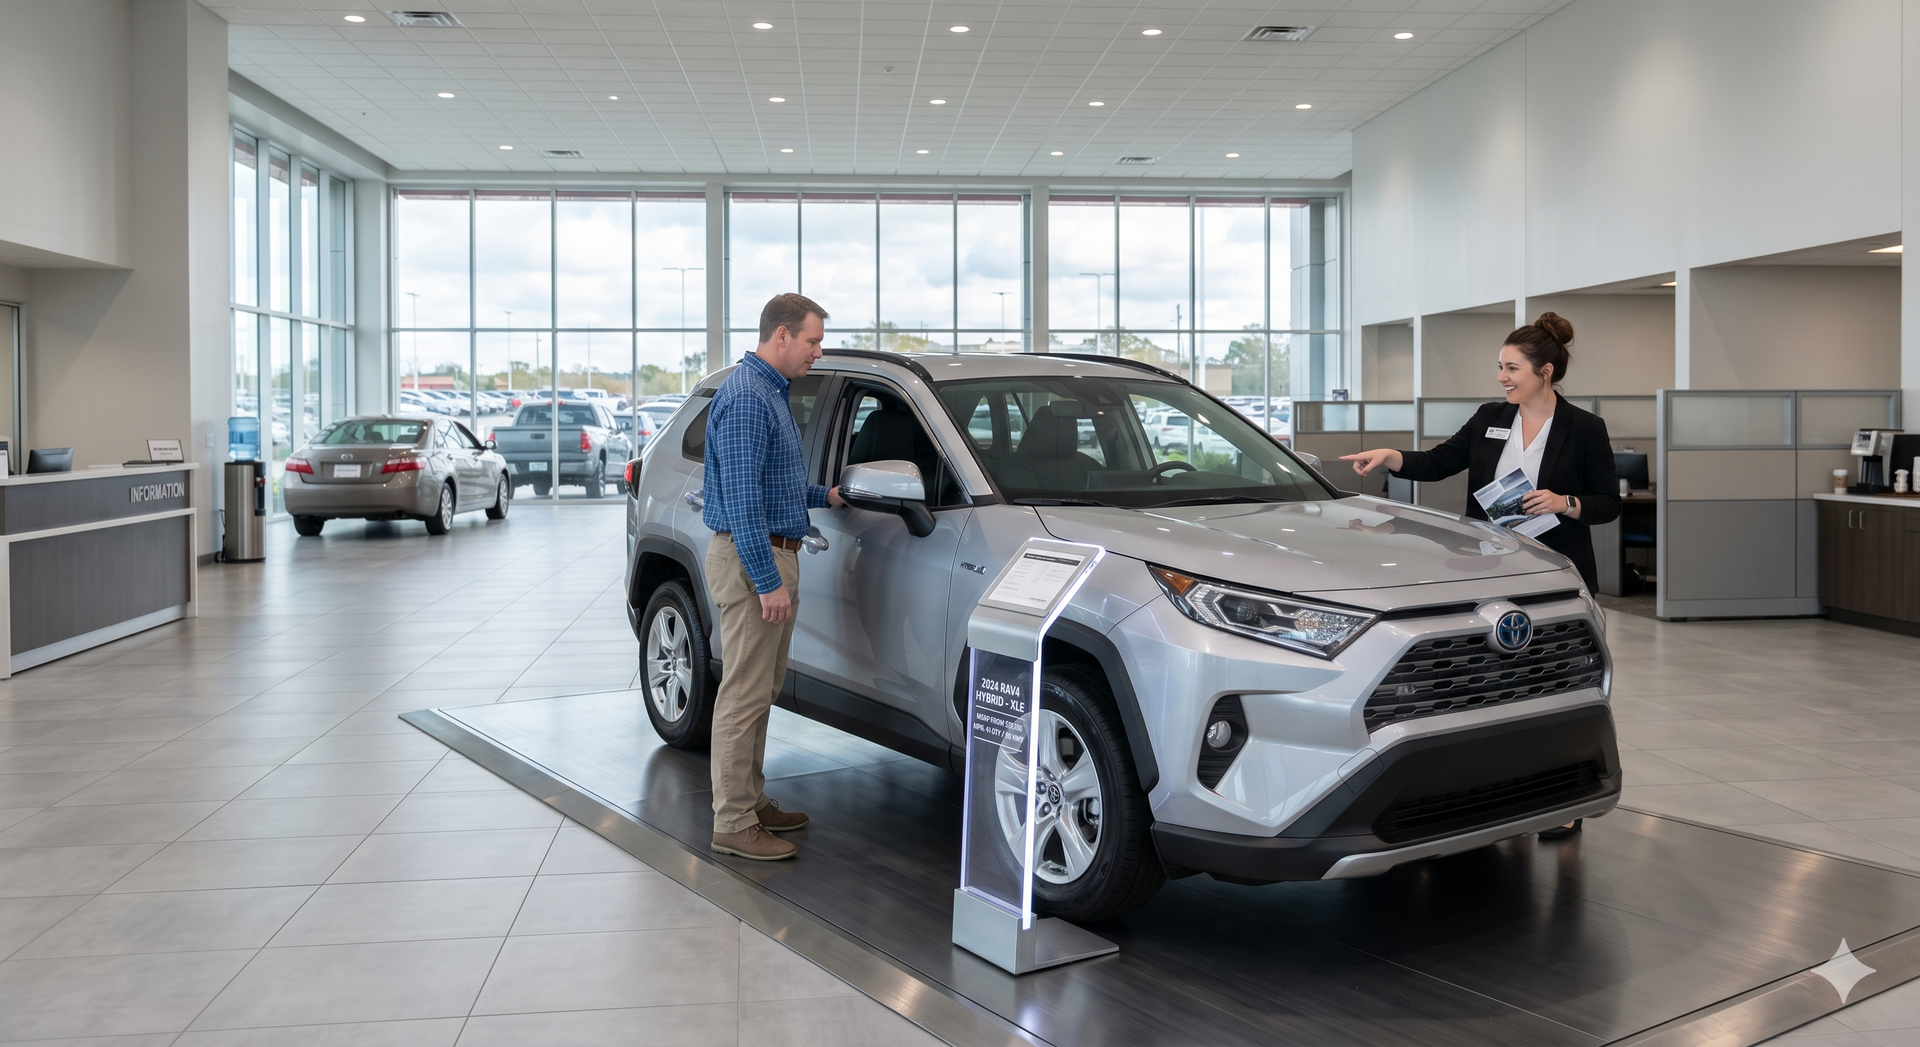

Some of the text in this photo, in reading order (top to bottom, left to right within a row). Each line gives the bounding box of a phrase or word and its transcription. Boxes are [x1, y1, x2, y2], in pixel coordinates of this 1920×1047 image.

[130, 482, 184, 502] INFORMATION
[981, 678, 1020, 697] 2024 RAV4
[976, 690, 1004, 706] HYBRID
[1010, 699, 1025, 713] XLE
[990, 717, 1004, 726] FROM
